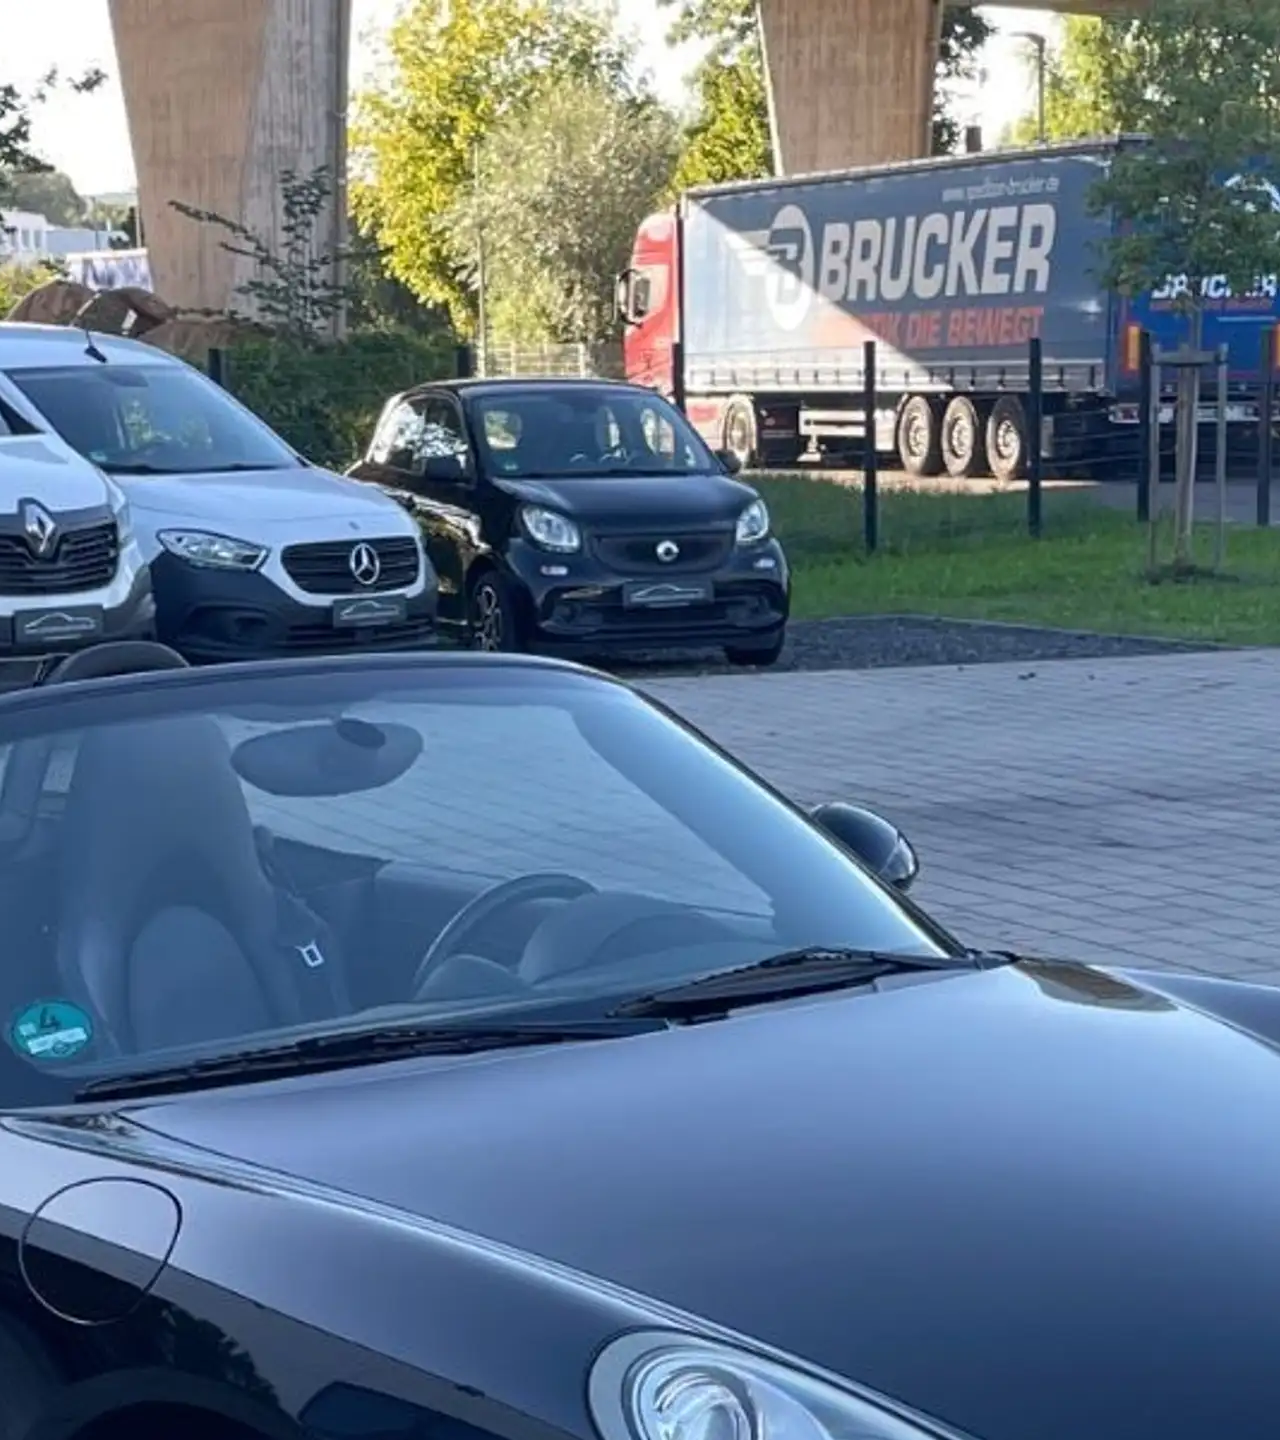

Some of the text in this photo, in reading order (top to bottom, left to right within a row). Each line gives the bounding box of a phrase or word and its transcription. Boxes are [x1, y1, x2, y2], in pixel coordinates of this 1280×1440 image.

[821, 203, 1057, 301] BRUCKER
[907, 310, 942, 348] DIE
[947, 305, 1045, 346] BEWEGT
